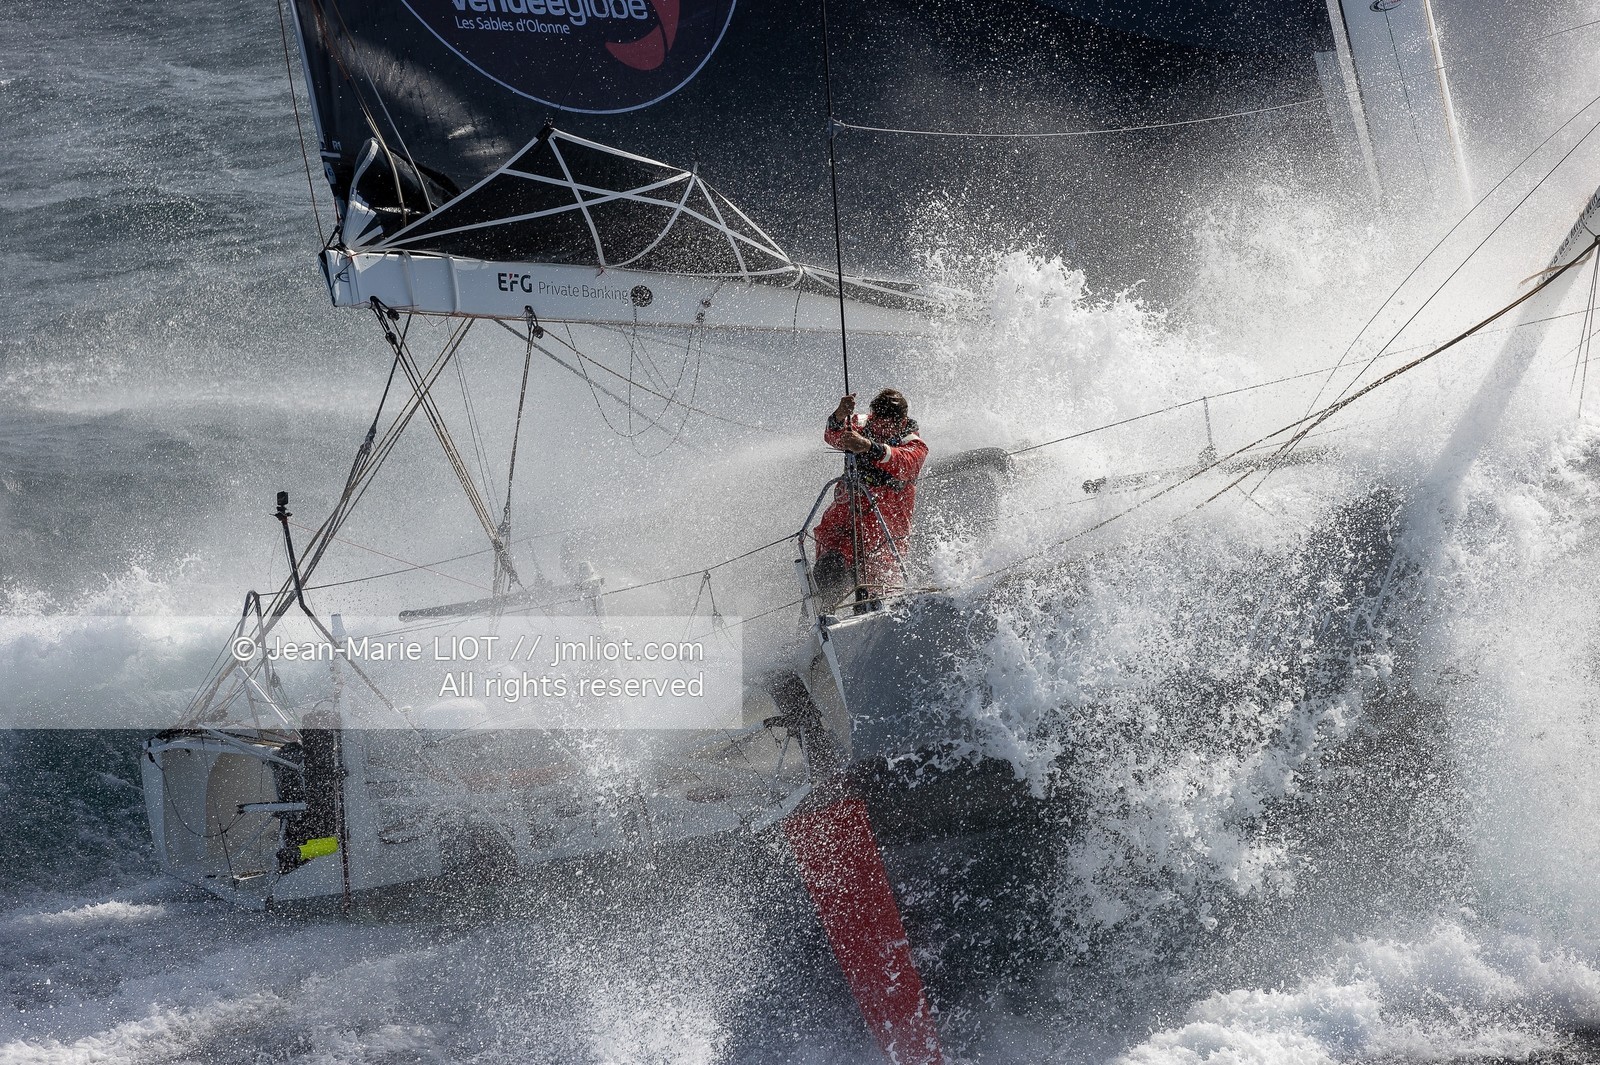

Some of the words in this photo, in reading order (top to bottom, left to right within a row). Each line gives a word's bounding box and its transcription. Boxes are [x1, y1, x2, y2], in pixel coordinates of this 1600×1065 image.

[455, 16, 475, 29] Les
[478, 17, 513, 31] Sables
[516, 19, 570, 34] d'Olonne
[497, 272, 533, 293] EFG
[538, 281, 580, 297] Private
[582, 285, 629, 304] Banking
